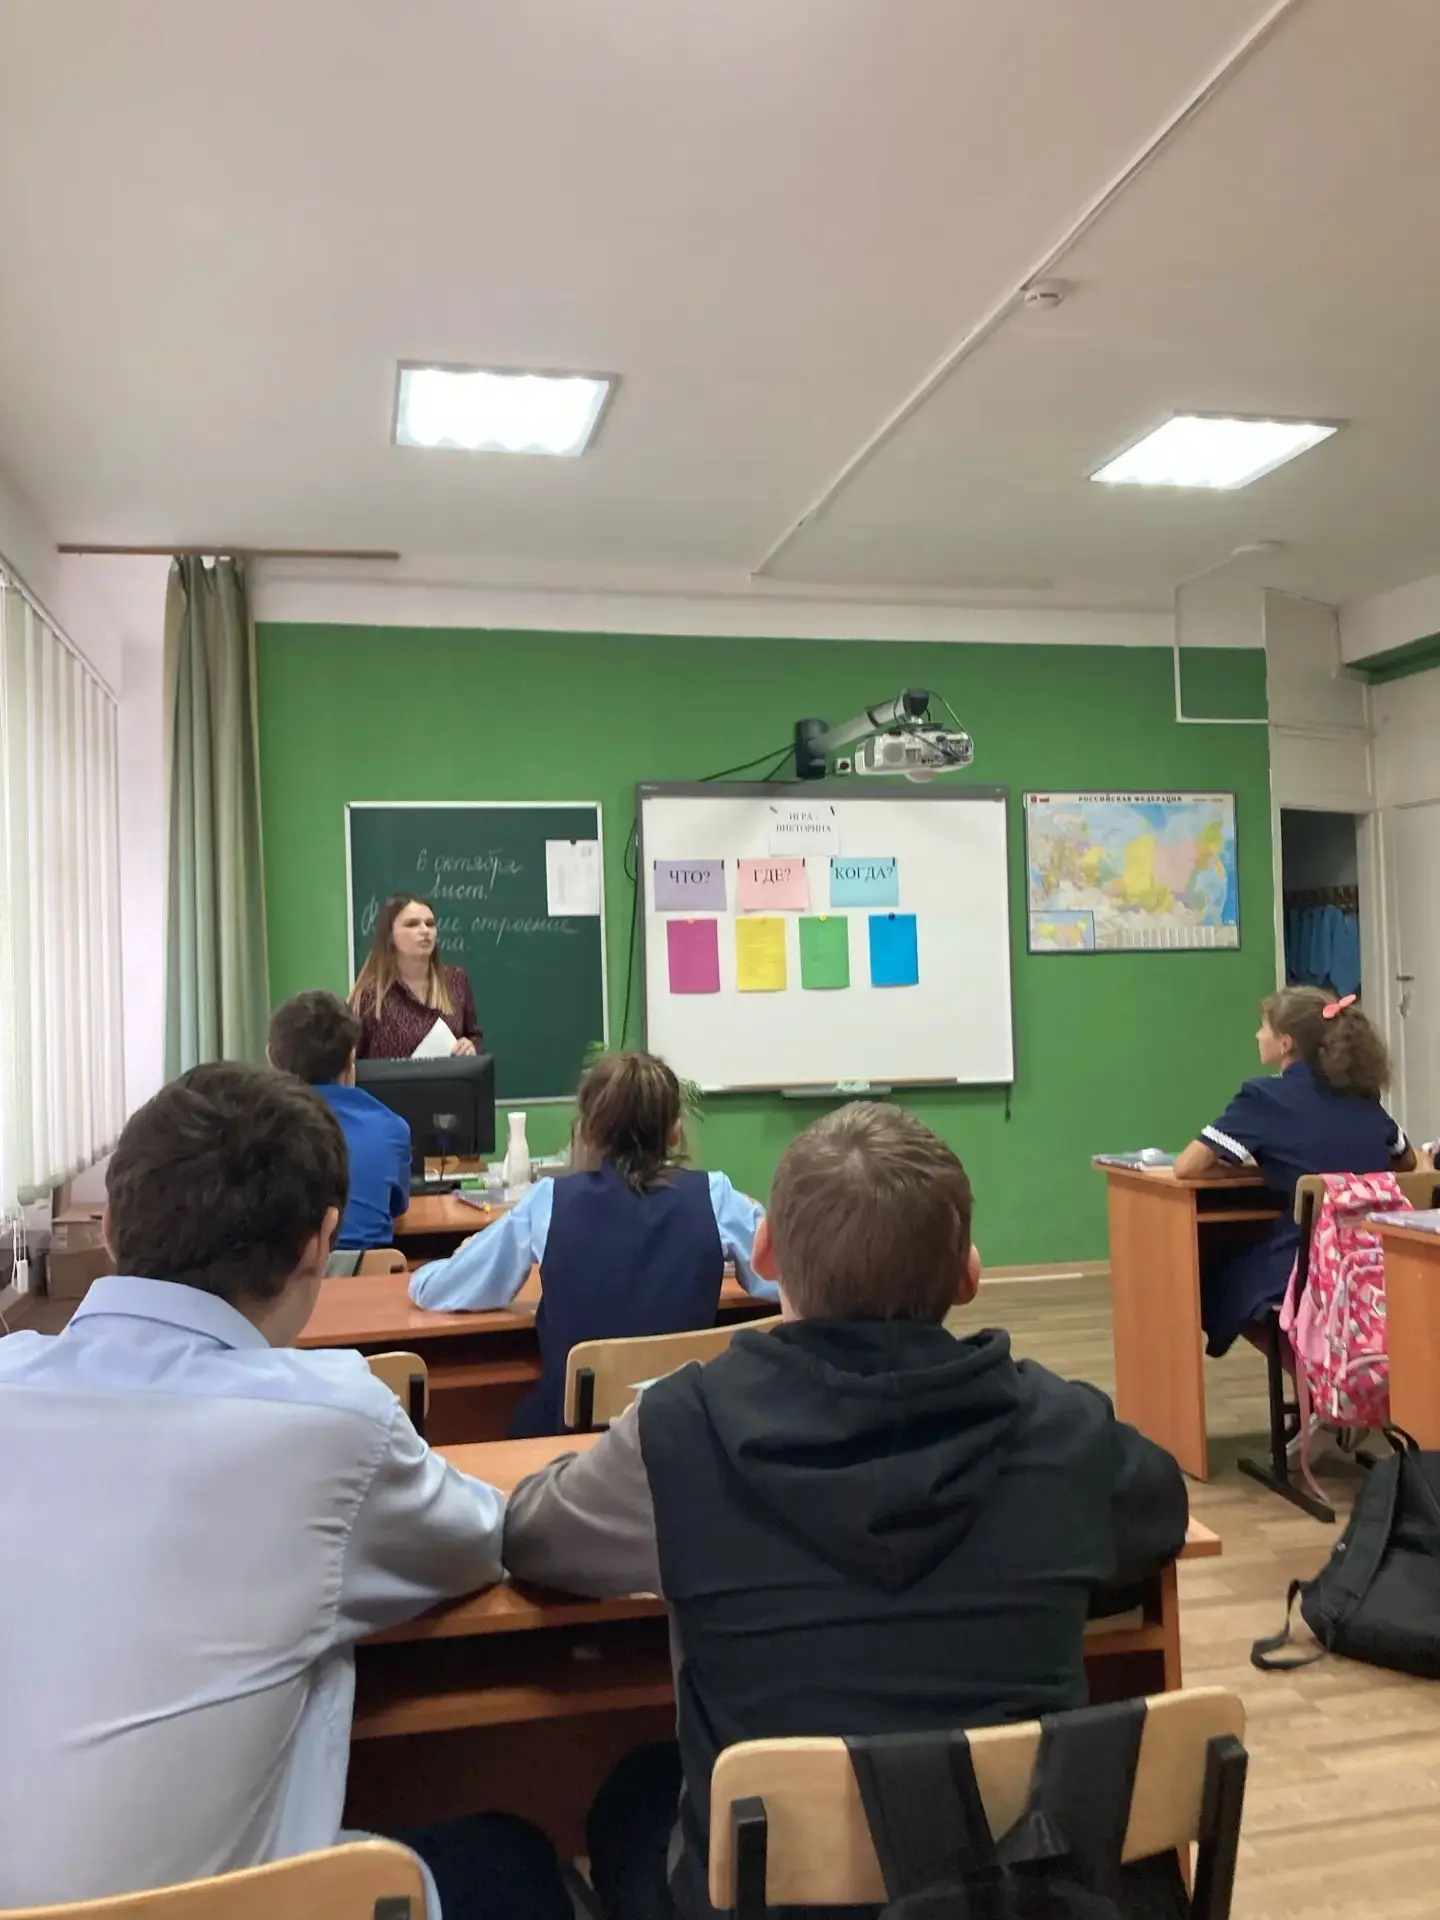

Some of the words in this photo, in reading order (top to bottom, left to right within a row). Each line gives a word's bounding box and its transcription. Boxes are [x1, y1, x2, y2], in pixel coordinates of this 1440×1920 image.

[1078, 795, 1132, 803] РОССИЙСКАЯ
[1134, 795, 1182, 804] ФЕДЕРАЦИЯ
[789, 812, 813, 821] ИГРА
[776, 824, 831, 833] ВИКТОРИНА
[434, 847, 525, 891] октября
[753, 868, 791, 883] ГДЕ?
[835, 865, 893, 882] КОГДА?
[669, 870, 711, 884] ЧТО?
